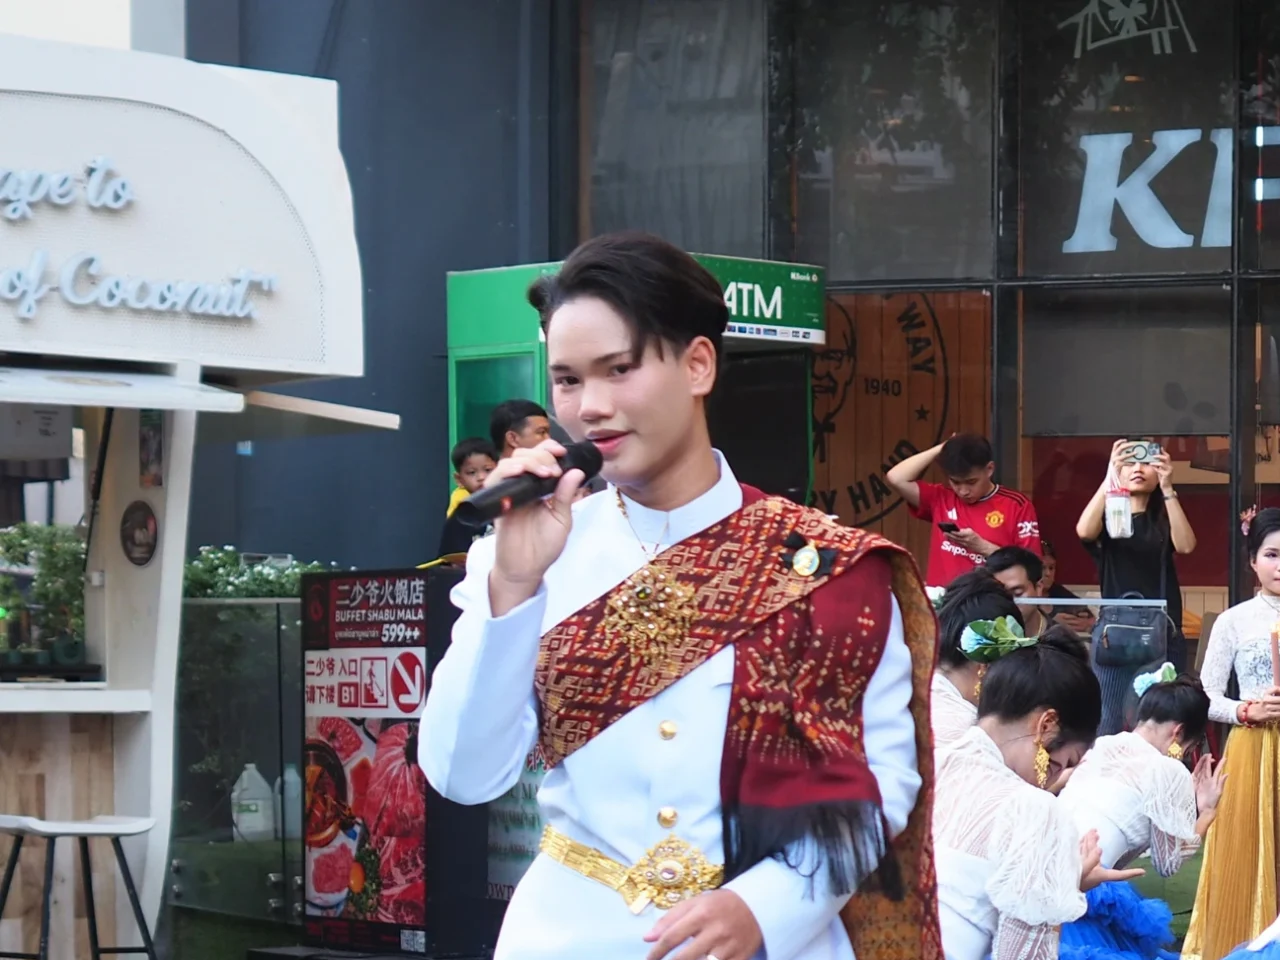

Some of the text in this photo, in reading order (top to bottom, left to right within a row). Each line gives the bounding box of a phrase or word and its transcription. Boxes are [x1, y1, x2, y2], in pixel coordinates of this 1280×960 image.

[83, 155, 134, 209] to
[0, 248, 50, 319] of
[723, 281, 782, 320] ATM
[897, 301, 935, 375] WAY
[863, 376, 902, 397] 1940
[336, 579, 425, 607] 二少爷火锅店
[335, 609, 424, 622] BUFFET SHABU MALA
[381, 623, 420, 643] 599++
[305, 657, 358, 676] 二少爷 入口
[305, 685, 355, 704] 请下楼 B1
